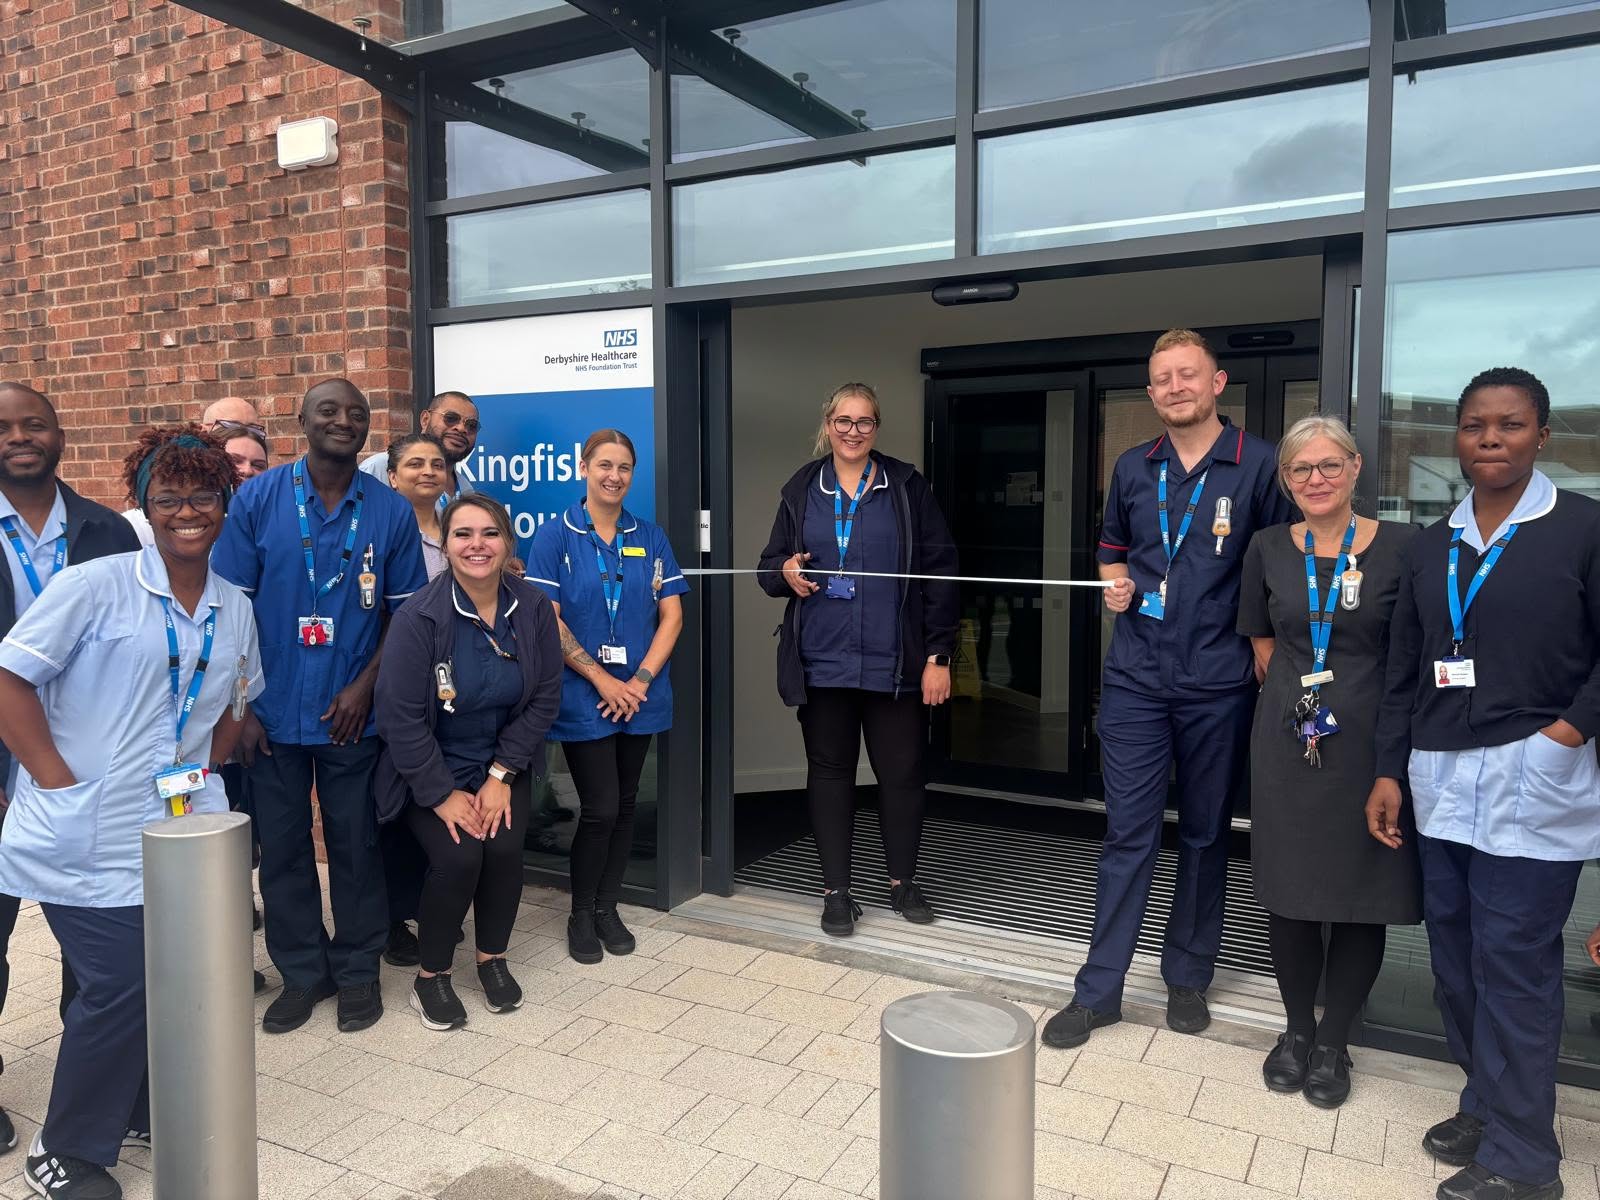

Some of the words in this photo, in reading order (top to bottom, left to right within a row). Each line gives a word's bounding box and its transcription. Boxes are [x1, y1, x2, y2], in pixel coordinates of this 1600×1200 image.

[605, 330, 636, 346] NHS
[544, 353, 589, 366] Derbyshire
[591, 351, 638, 362] Healthcare
[588, 363, 622, 371] Foundation
[350, 517, 358, 531] NHS
[1478, 562, 1491, 577] NHS
[1308, 575, 1317, 589] NHS
[1331, 575, 1341, 590] NHS
[205, 622, 214, 637] NHS
[1317, 647, 1326, 664] NHS
[183, 696, 195, 713] NHS
